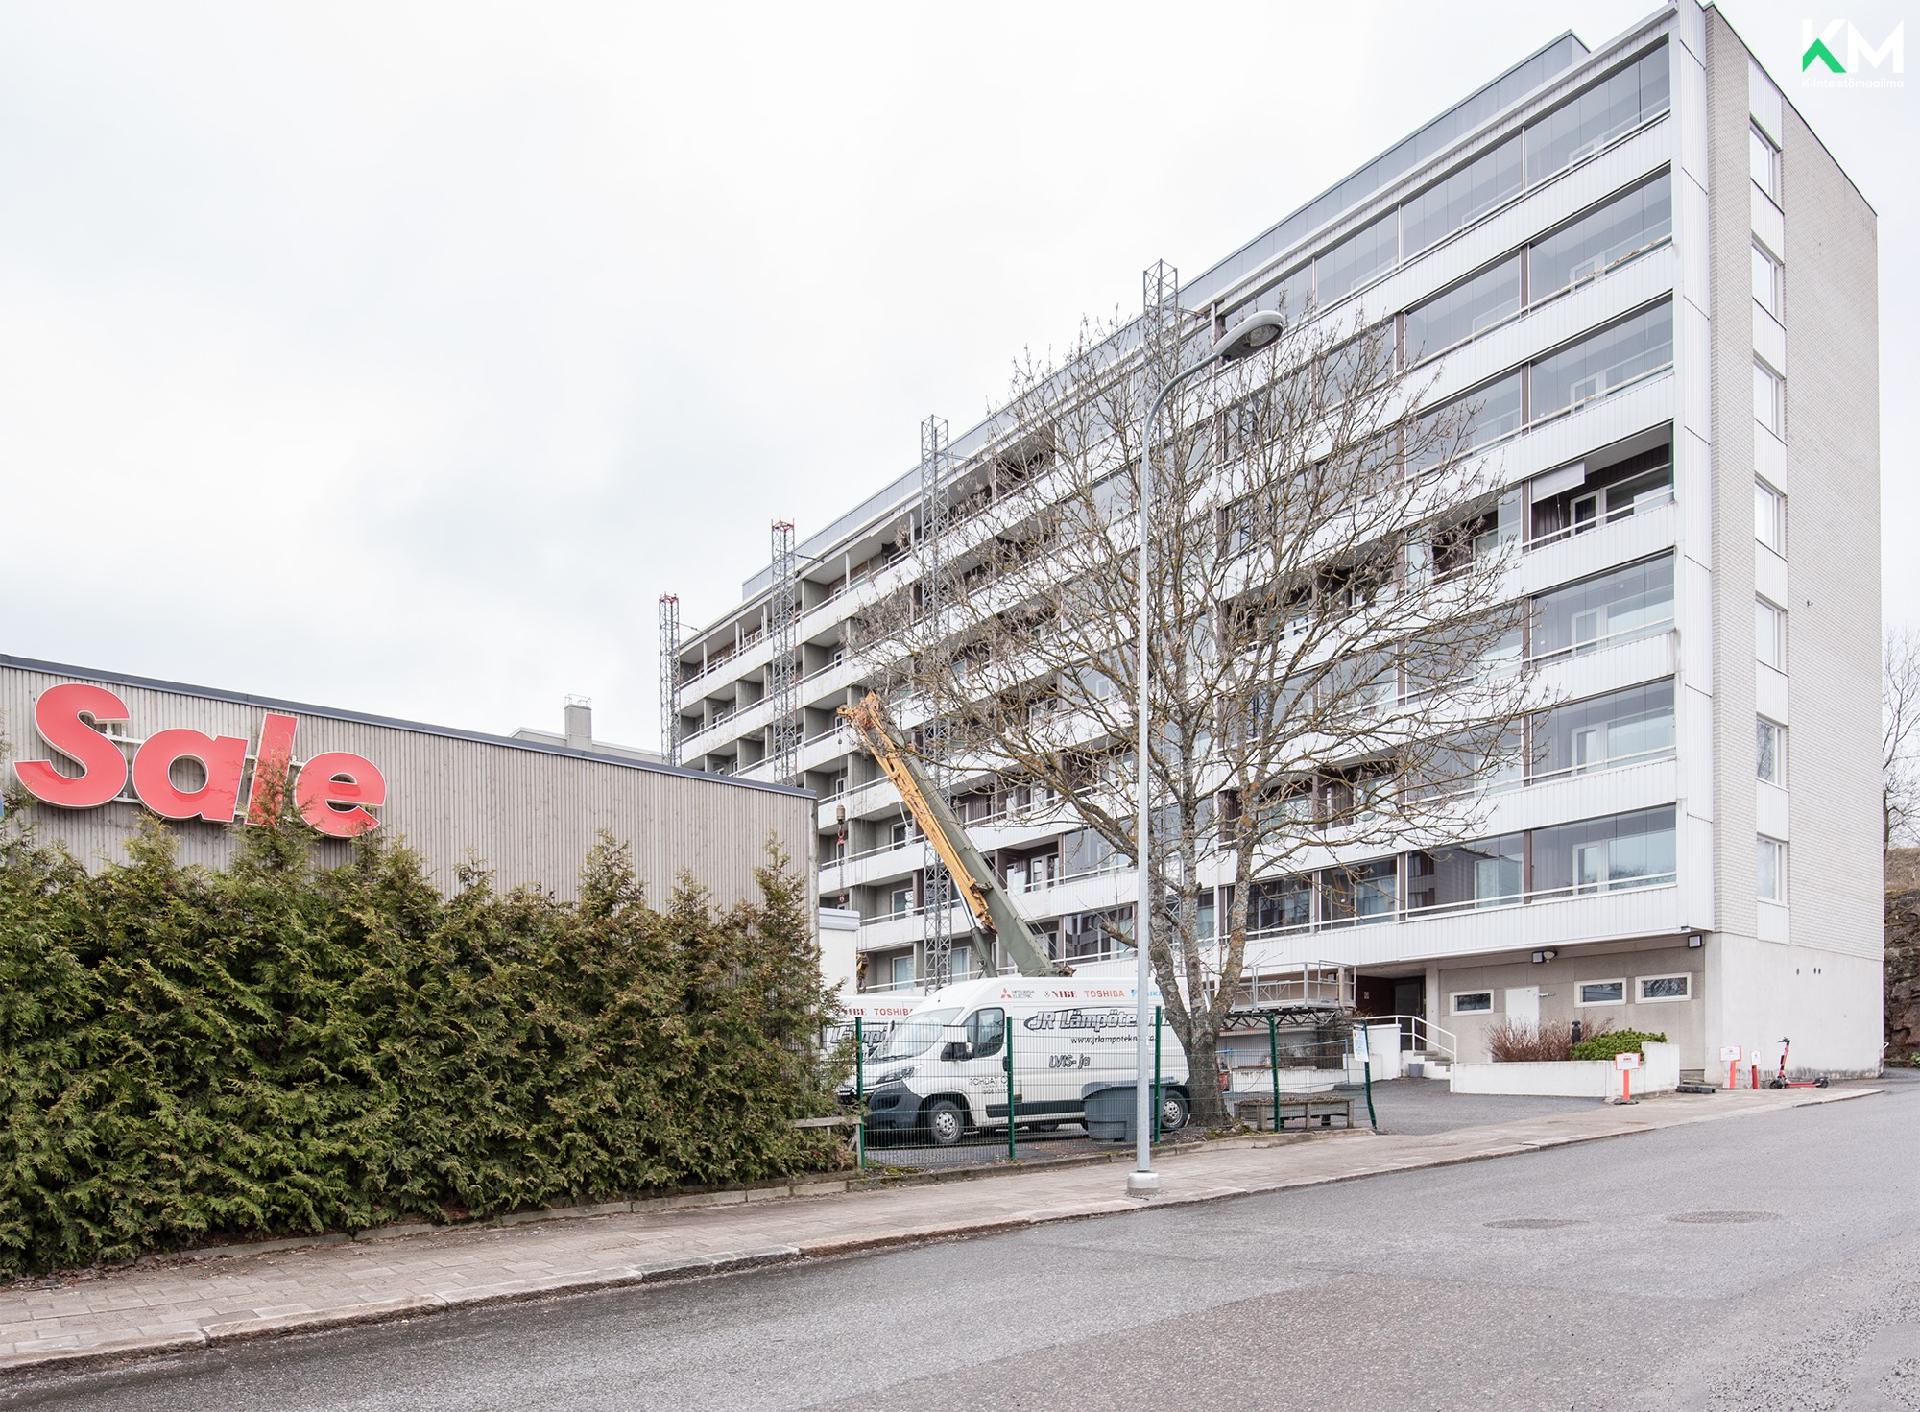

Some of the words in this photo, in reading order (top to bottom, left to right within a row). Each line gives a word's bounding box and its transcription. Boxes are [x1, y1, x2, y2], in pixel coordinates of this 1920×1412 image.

[13, 682, 388, 840] Sale
[1083, 990, 1125, 998] TOSHIBA
[1030, 1011, 1055, 1030] JR
